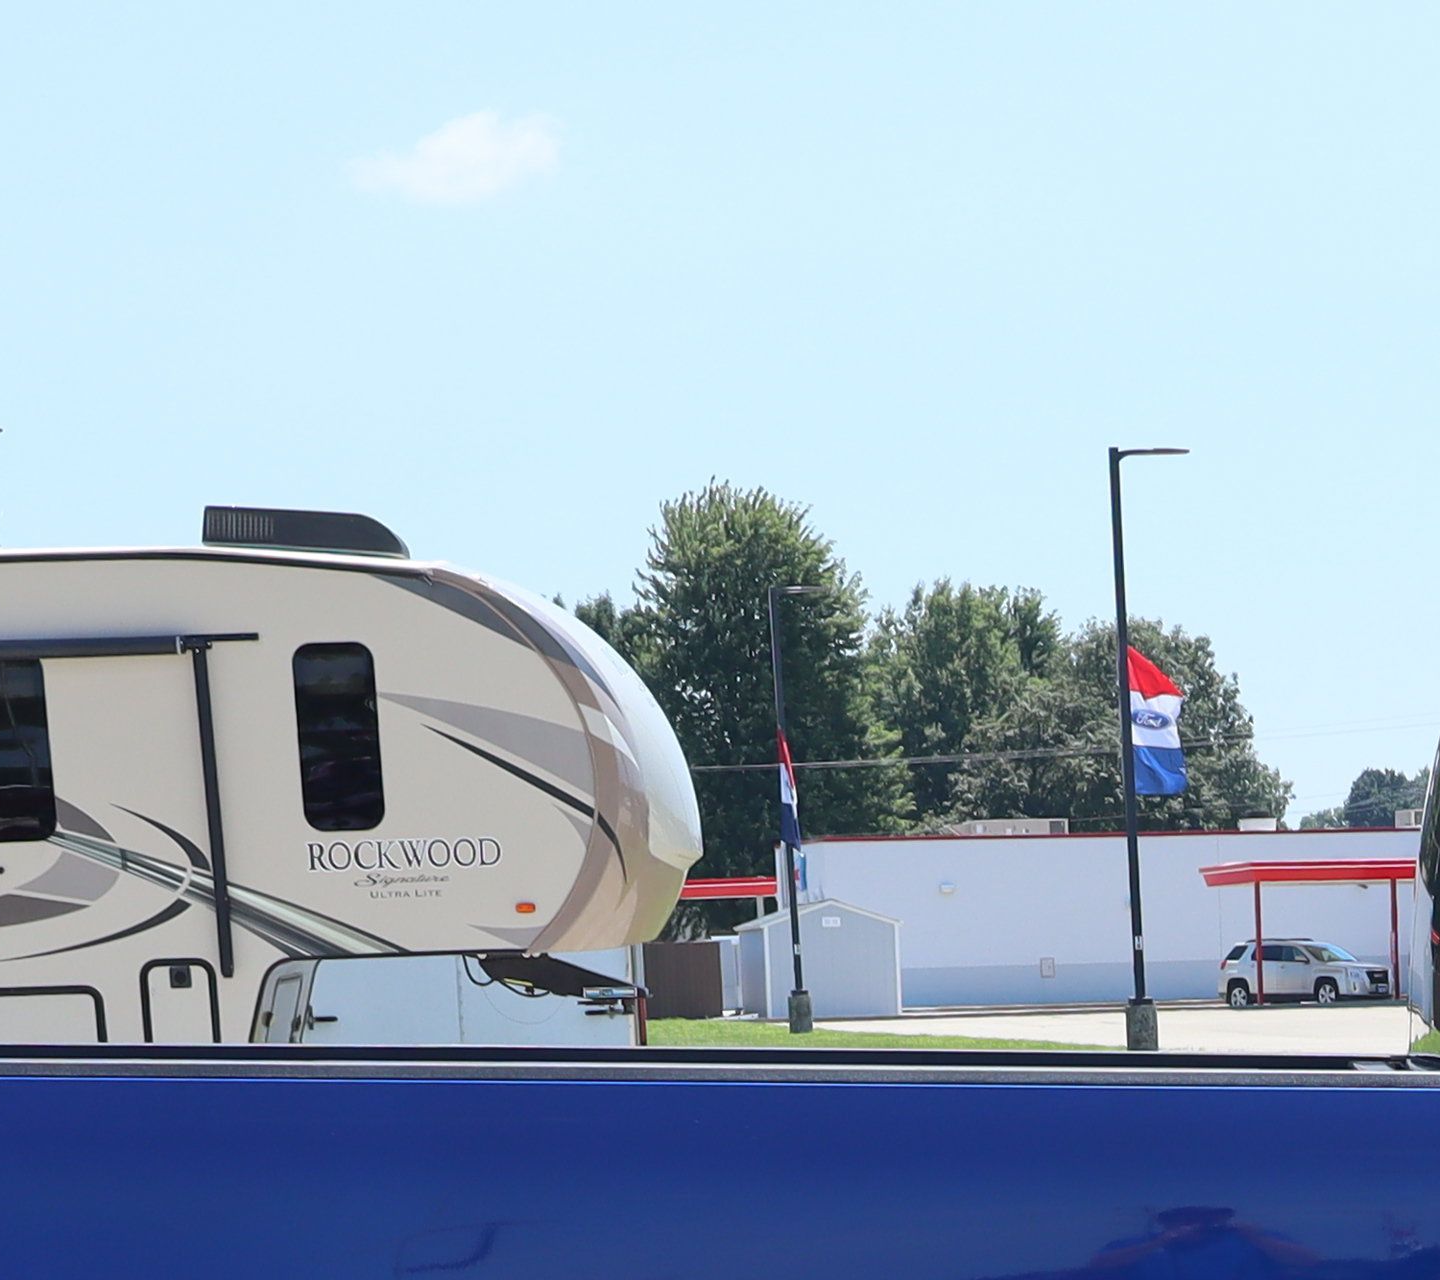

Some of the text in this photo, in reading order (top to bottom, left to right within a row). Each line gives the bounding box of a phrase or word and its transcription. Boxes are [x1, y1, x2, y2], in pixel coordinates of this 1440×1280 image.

[1136, 711, 1163, 728] Ford
[307, 838, 502, 872] ROCKWOOD
[354, 872, 450, 888] Signature
[370, 888, 442, 899] ULTRA LITE
